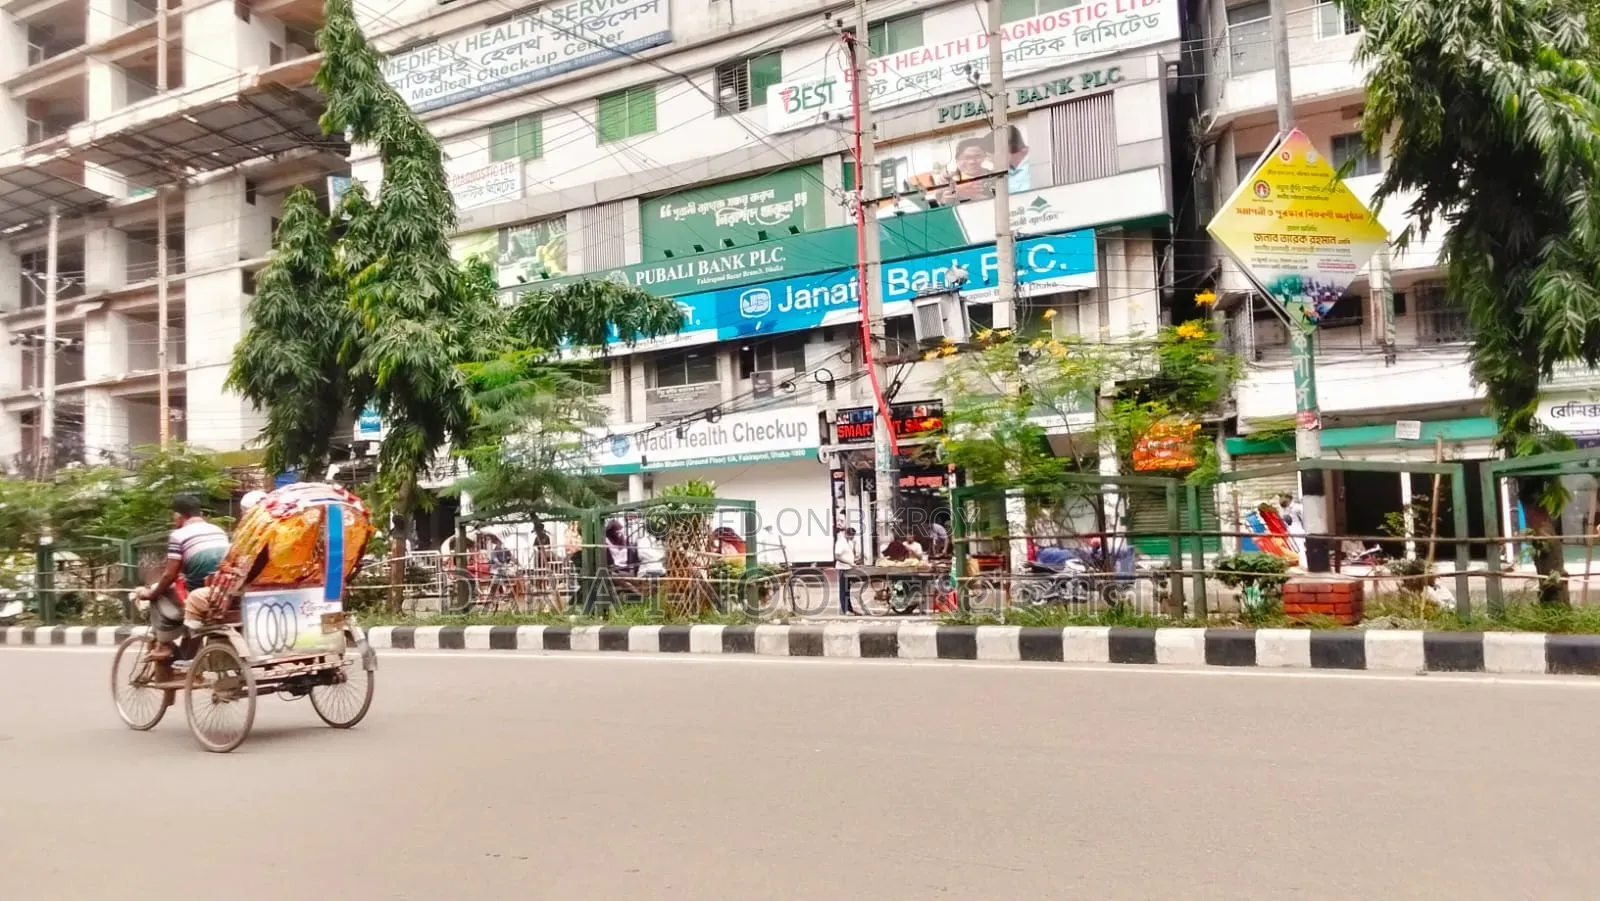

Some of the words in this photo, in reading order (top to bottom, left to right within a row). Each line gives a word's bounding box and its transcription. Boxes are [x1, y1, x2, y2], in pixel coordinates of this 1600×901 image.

[465, 15, 544, 53] HEALTH
[895, 38, 970, 71] HEALTH
[976, 2, 1108, 49] DAGNOSTIC
[411, 74, 472, 100] Medical
[477, 50, 558, 82] Check-up
[563, 30, 624, 56] Center
[938, 92, 1010, 123] PUBA
[1016, 77, 1074, 105] BANK
[635, 263, 694, 286] PUBALI
[698, 253, 746, 276] BANK
[749, 246, 786, 267] PLC.
[777, 276, 863, 312] Janat
[981, 243, 1067, 281] PC.
[634, 430, 673, 452] Wadi
[677, 425, 728, 449] Health
[732, 418, 808, 442] Checkup
